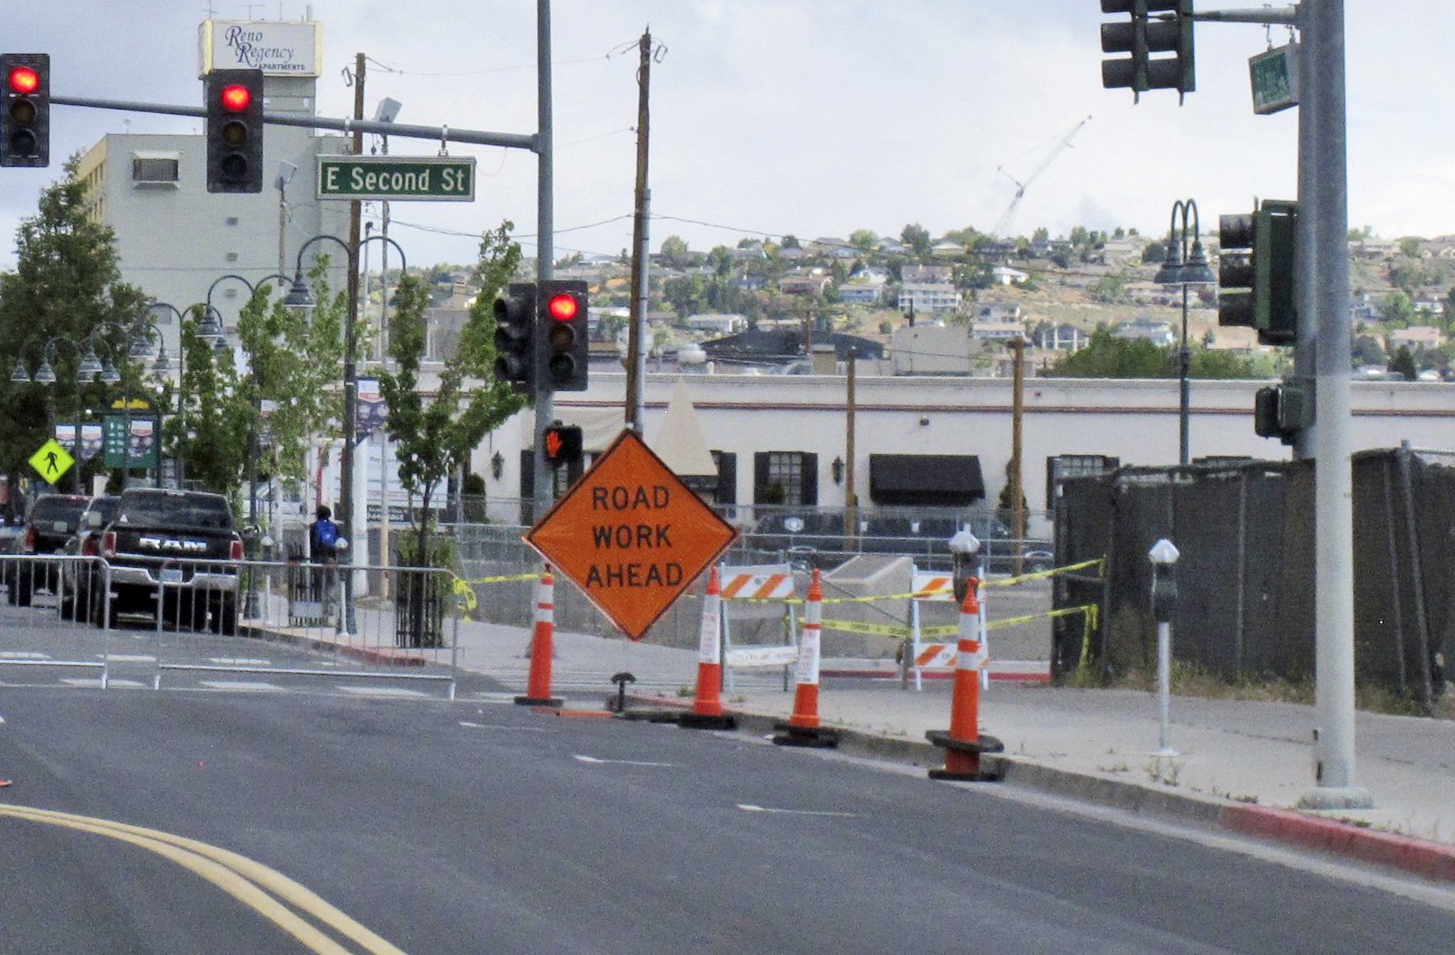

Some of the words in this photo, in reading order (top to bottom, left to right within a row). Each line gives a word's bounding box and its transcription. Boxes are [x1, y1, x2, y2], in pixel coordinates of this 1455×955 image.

[225, 25, 263, 46] Reno
[235, 42, 294, 67] Regency
[326, 166, 340, 190] E
[351, 166, 430, 191] Second
[441, 167, 465, 192] St
[592, 486, 670, 510] ROAD
[139, 537, 207, 551] RAM
[592, 524, 672, 549] WORK
[586, 563, 683, 587] AHEAD
